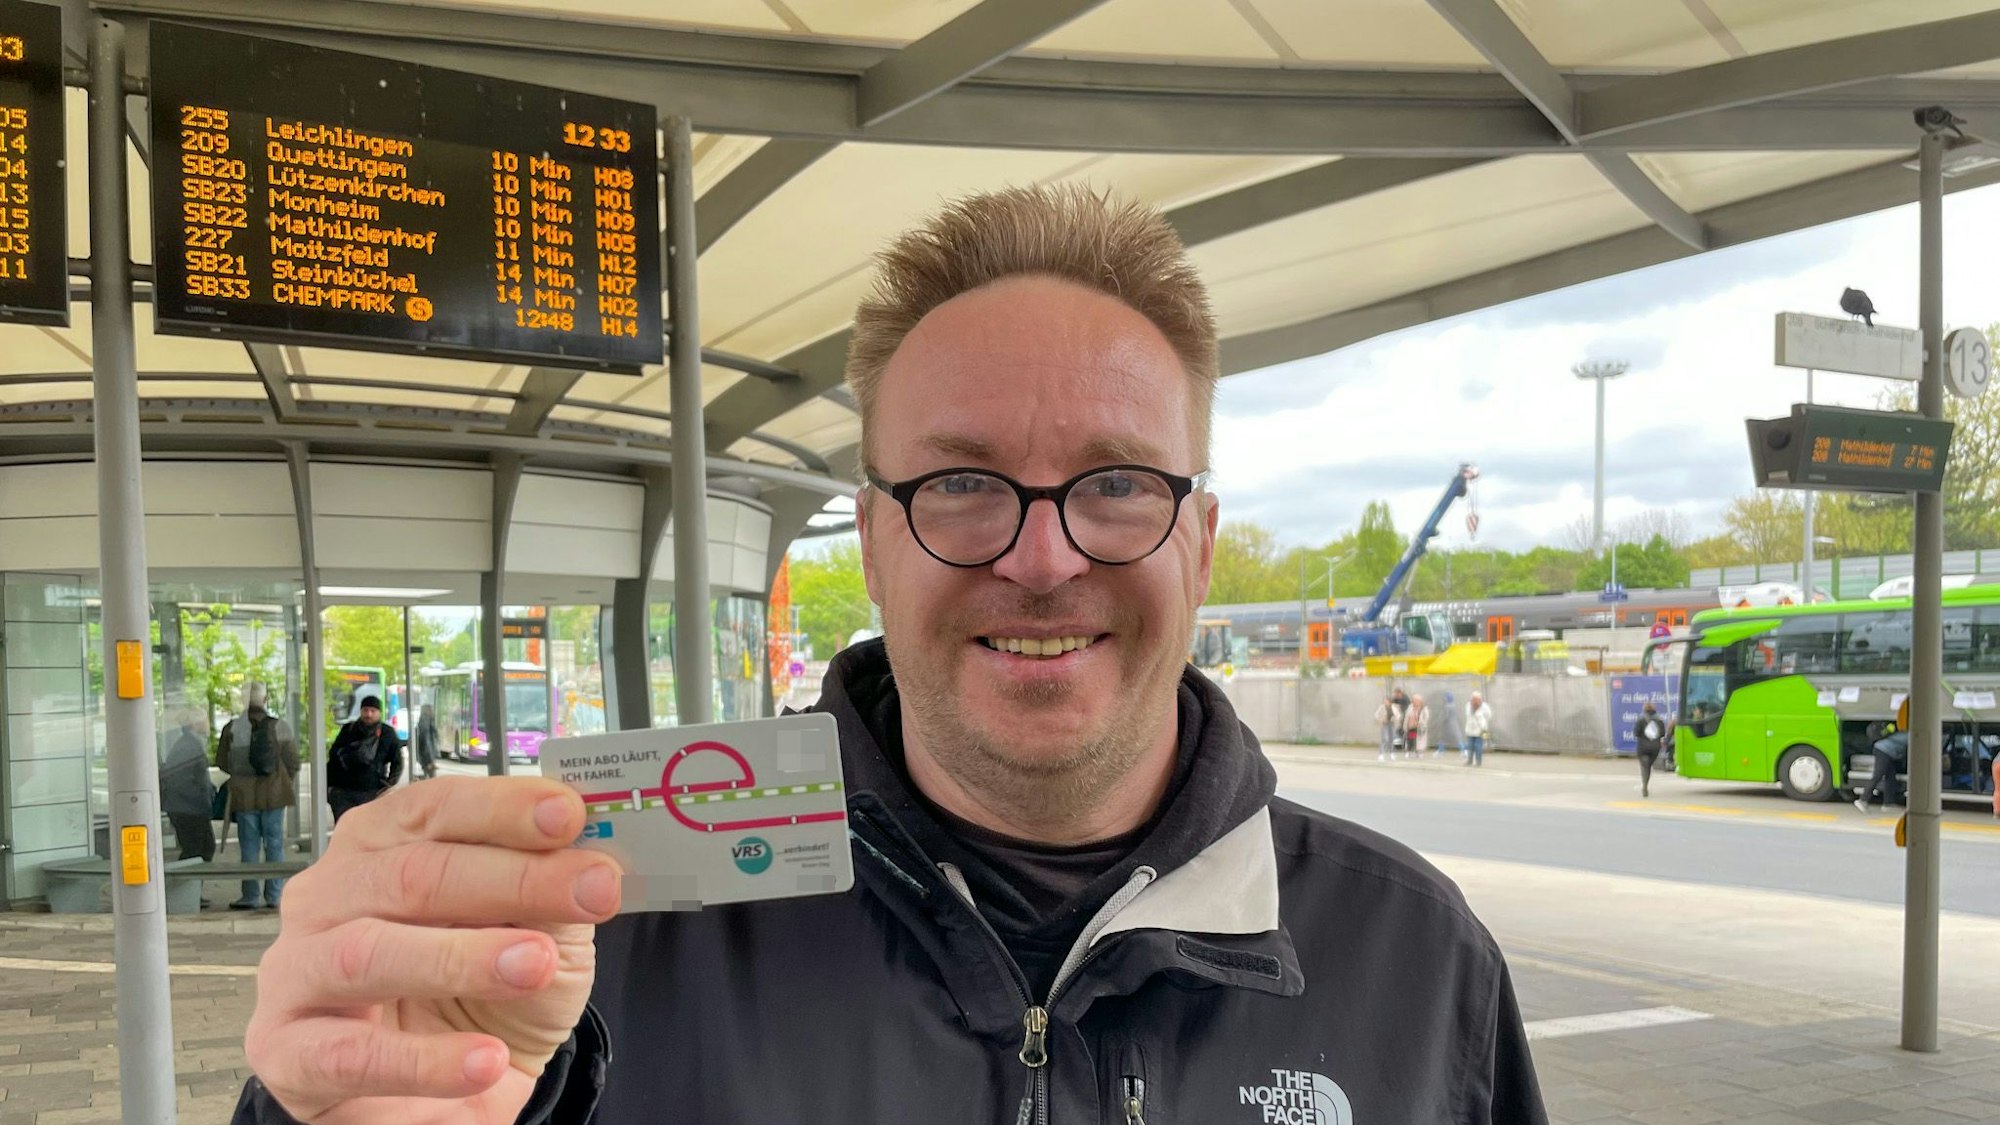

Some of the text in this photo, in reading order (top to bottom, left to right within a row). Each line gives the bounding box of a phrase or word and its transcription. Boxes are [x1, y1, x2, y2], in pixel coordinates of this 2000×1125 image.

[180, 106, 634, 190] 255 Leichlingen 10 Min H08
[181, 130, 633, 212] 209 Quettingen 10 Min H01
[182, 154, 636, 232] SB20 Lützenkirchen 10 Min H09
[182, 178, 247, 204] SB23
[268, 188, 380, 221] Monheim
[494, 218, 521, 239] 10
[532, 222, 573, 246] Min
[183, 202, 637, 276] SB22 Mathildenhof 11 Min H12
[184, 226, 638, 296] 227 Moitzfeld 14 Min H07
[185, 250, 638, 318] SB21 Steinbüchel 14 Min H02
[186, 274, 250, 300] SB33
[272, 283, 396, 314] CHEMPARK
[516, 308, 575, 332] 12:48
[601, 316, 639, 339] H14
[1954, 338, 1988, 385] 13
[560, 750, 661, 768] MEIN ABO LÄUFT,
[561, 768, 626, 783] ICH FAHRE.
[731, 844, 762, 858] VRS
[1238, 1086, 1314, 1109] NORTH
[1271, 1068, 1312, 1090] THE
[1262, 1104, 1316, 1125] FACE
